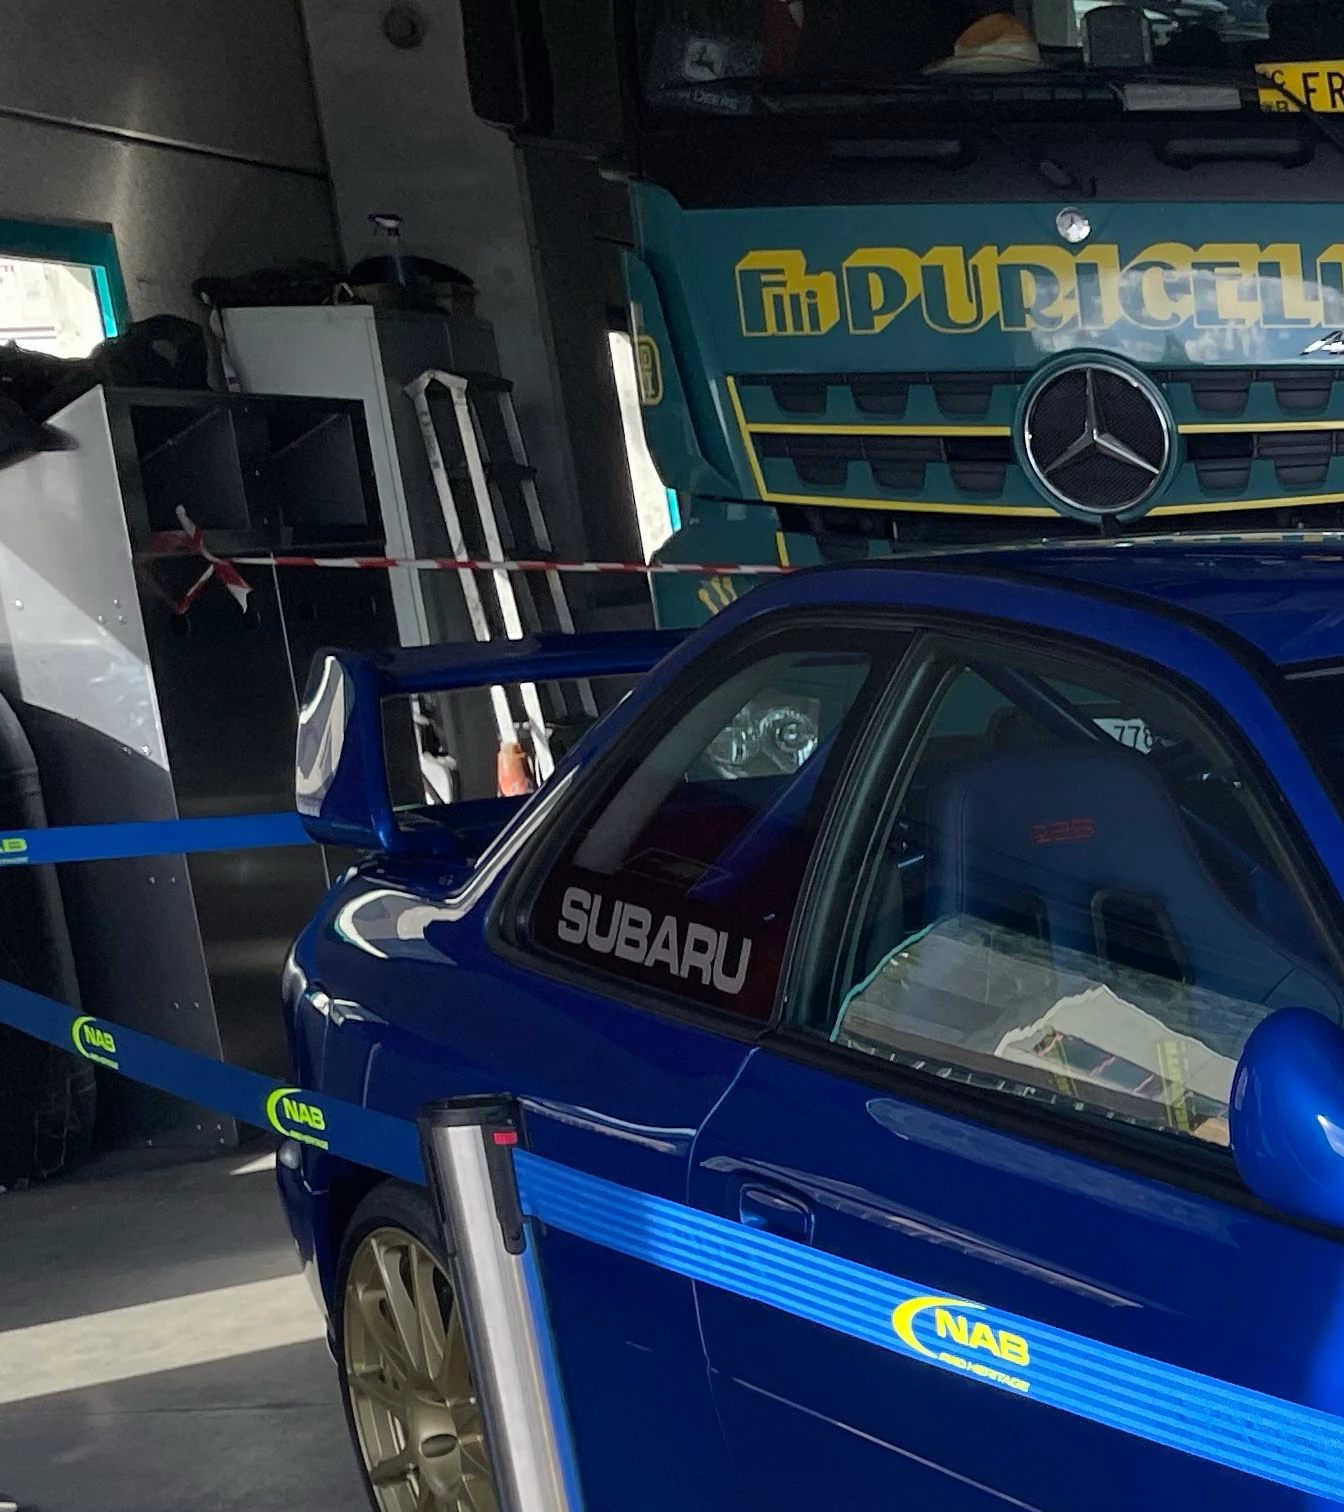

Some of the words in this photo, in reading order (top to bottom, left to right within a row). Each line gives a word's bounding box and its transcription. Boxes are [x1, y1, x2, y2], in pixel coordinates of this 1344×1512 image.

[558, 886, 753, 995] SUBARU
[83, 1024, 117, 1053] NAB
[282, 1097, 326, 1131] NAB
[935, 1308, 1030, 1367] NAB
